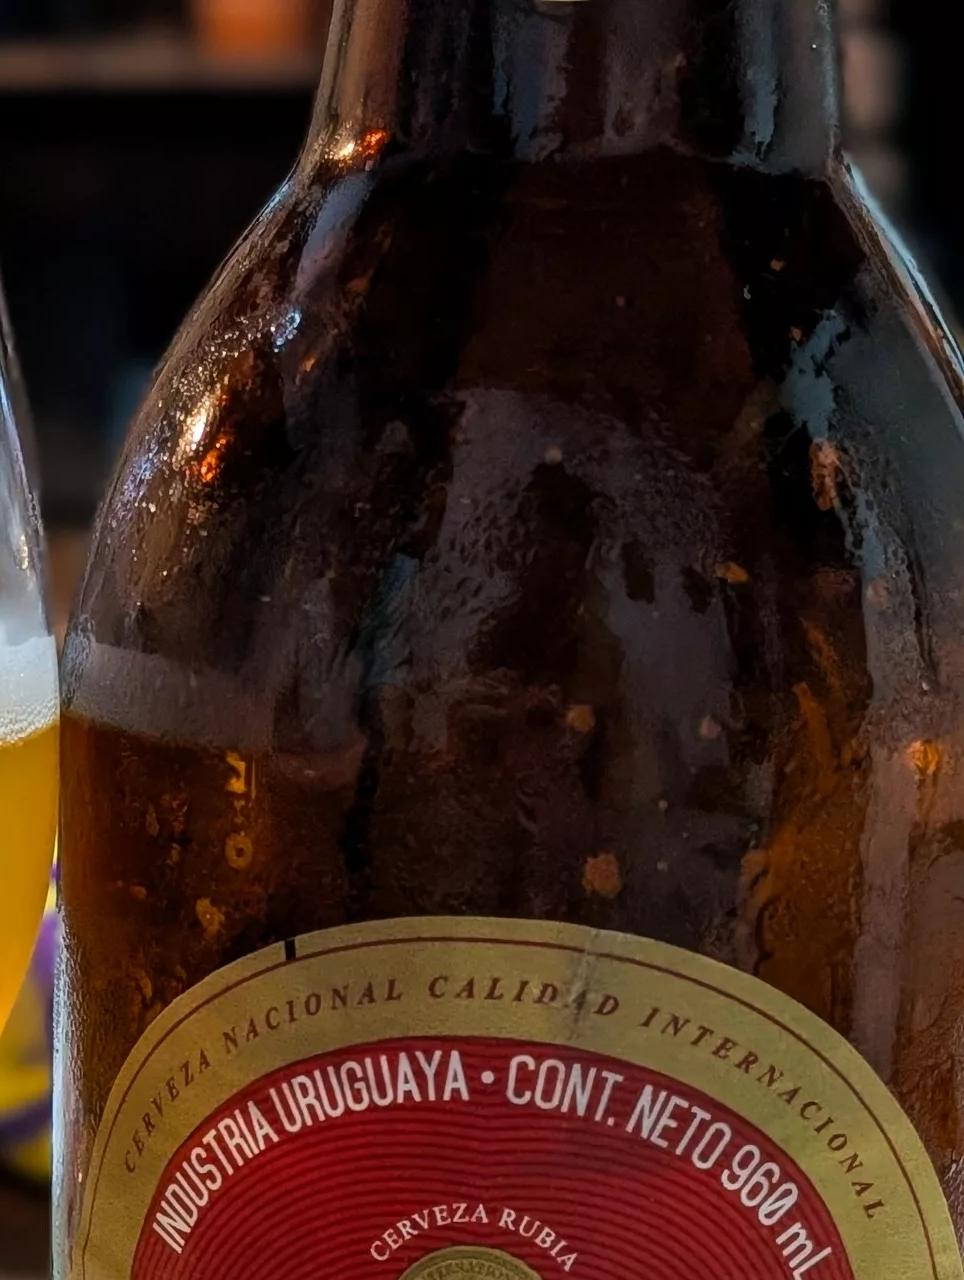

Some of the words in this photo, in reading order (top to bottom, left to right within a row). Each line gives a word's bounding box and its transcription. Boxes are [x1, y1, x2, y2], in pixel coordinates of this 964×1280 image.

[125, 1049, 210, 1173] CERVEZA
[222, 978, 402, 1054] NACIONAL
[428, 976, 620, 1015] CALIDAD
[638, 1007, 884, 1219] INTERNACIONAL
[152, 1100, 279, 1254] INDUSTRIA
[269, 1050, 470, 1133] URUGUAYA
[506, 1054, 624, 1126] CONT.
[625, 1084, 732, 1170] NETO
[721, 1144, 799, 1226] 960
[370, 1203, 489, 1261] CERVEZA
[498, 1207, 578, 1272] RUBIA
